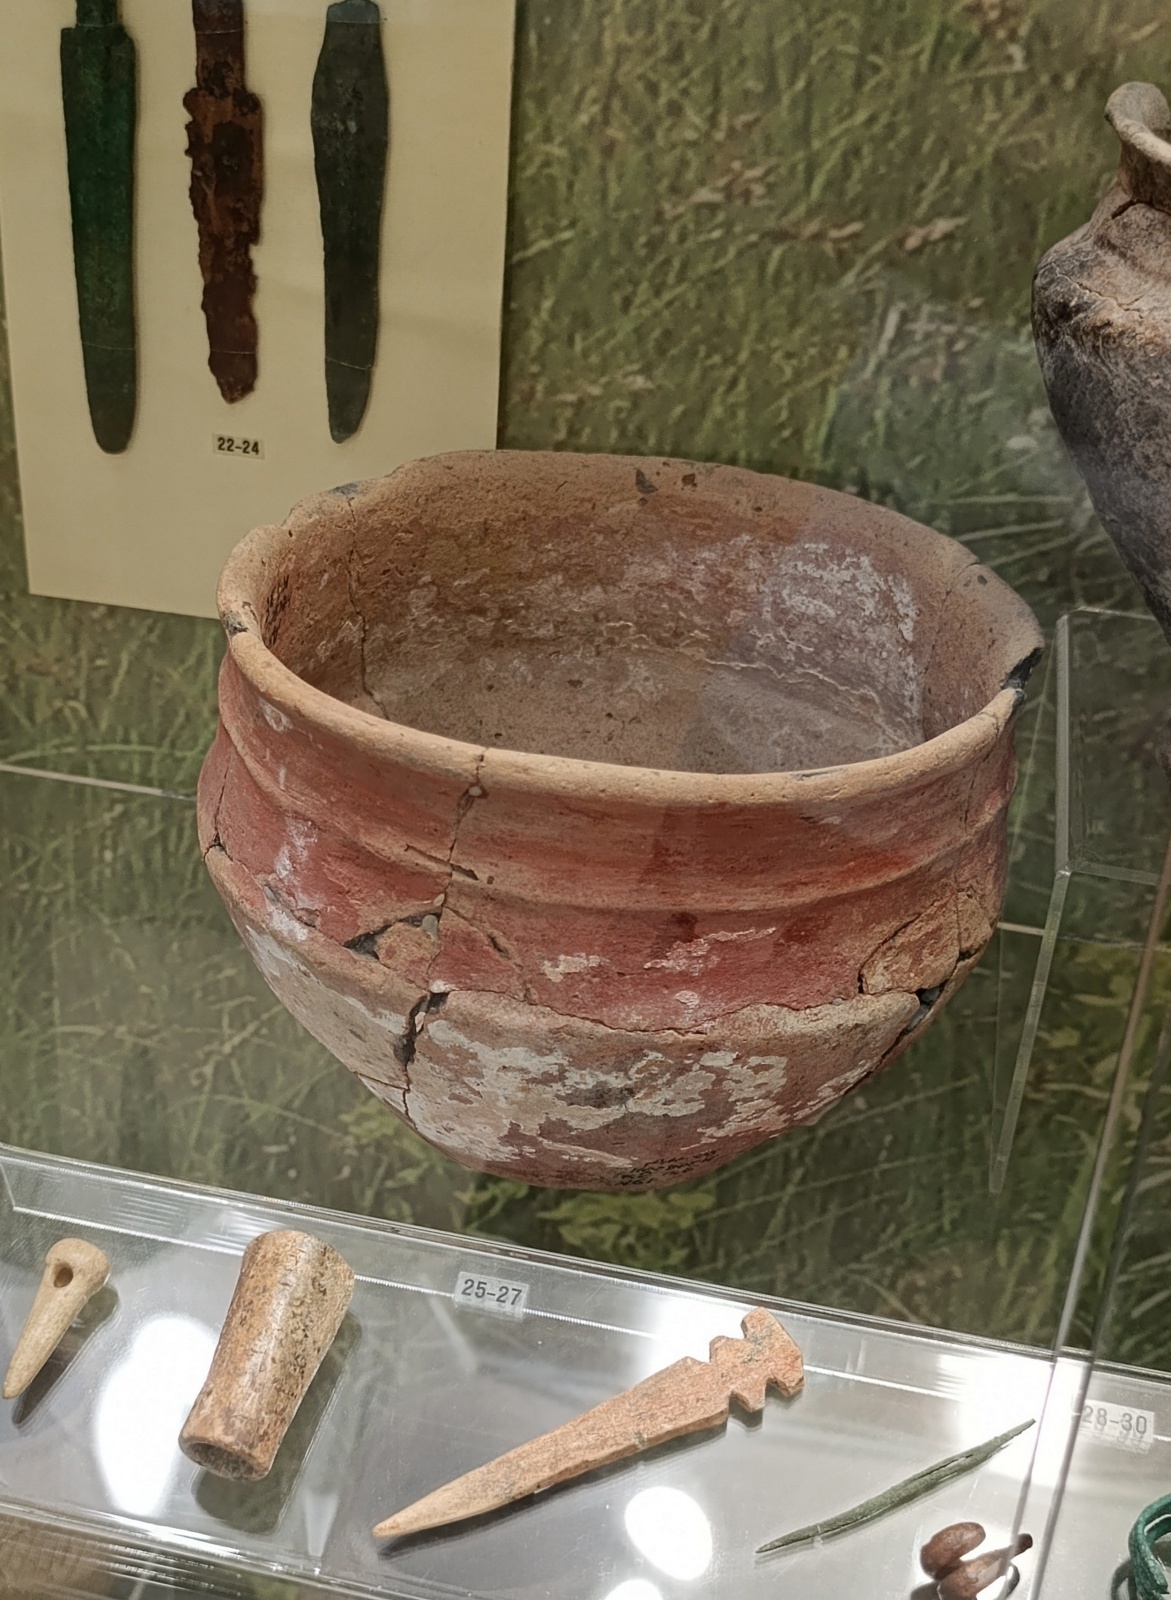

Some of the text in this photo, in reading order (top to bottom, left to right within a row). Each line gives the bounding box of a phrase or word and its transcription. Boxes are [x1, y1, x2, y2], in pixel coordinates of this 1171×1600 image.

[217, 437, 260, 456] 22-24
[461, 1278, 523, 1306] 25-27
[1081, 1405, 1148, 1435] 28-30
